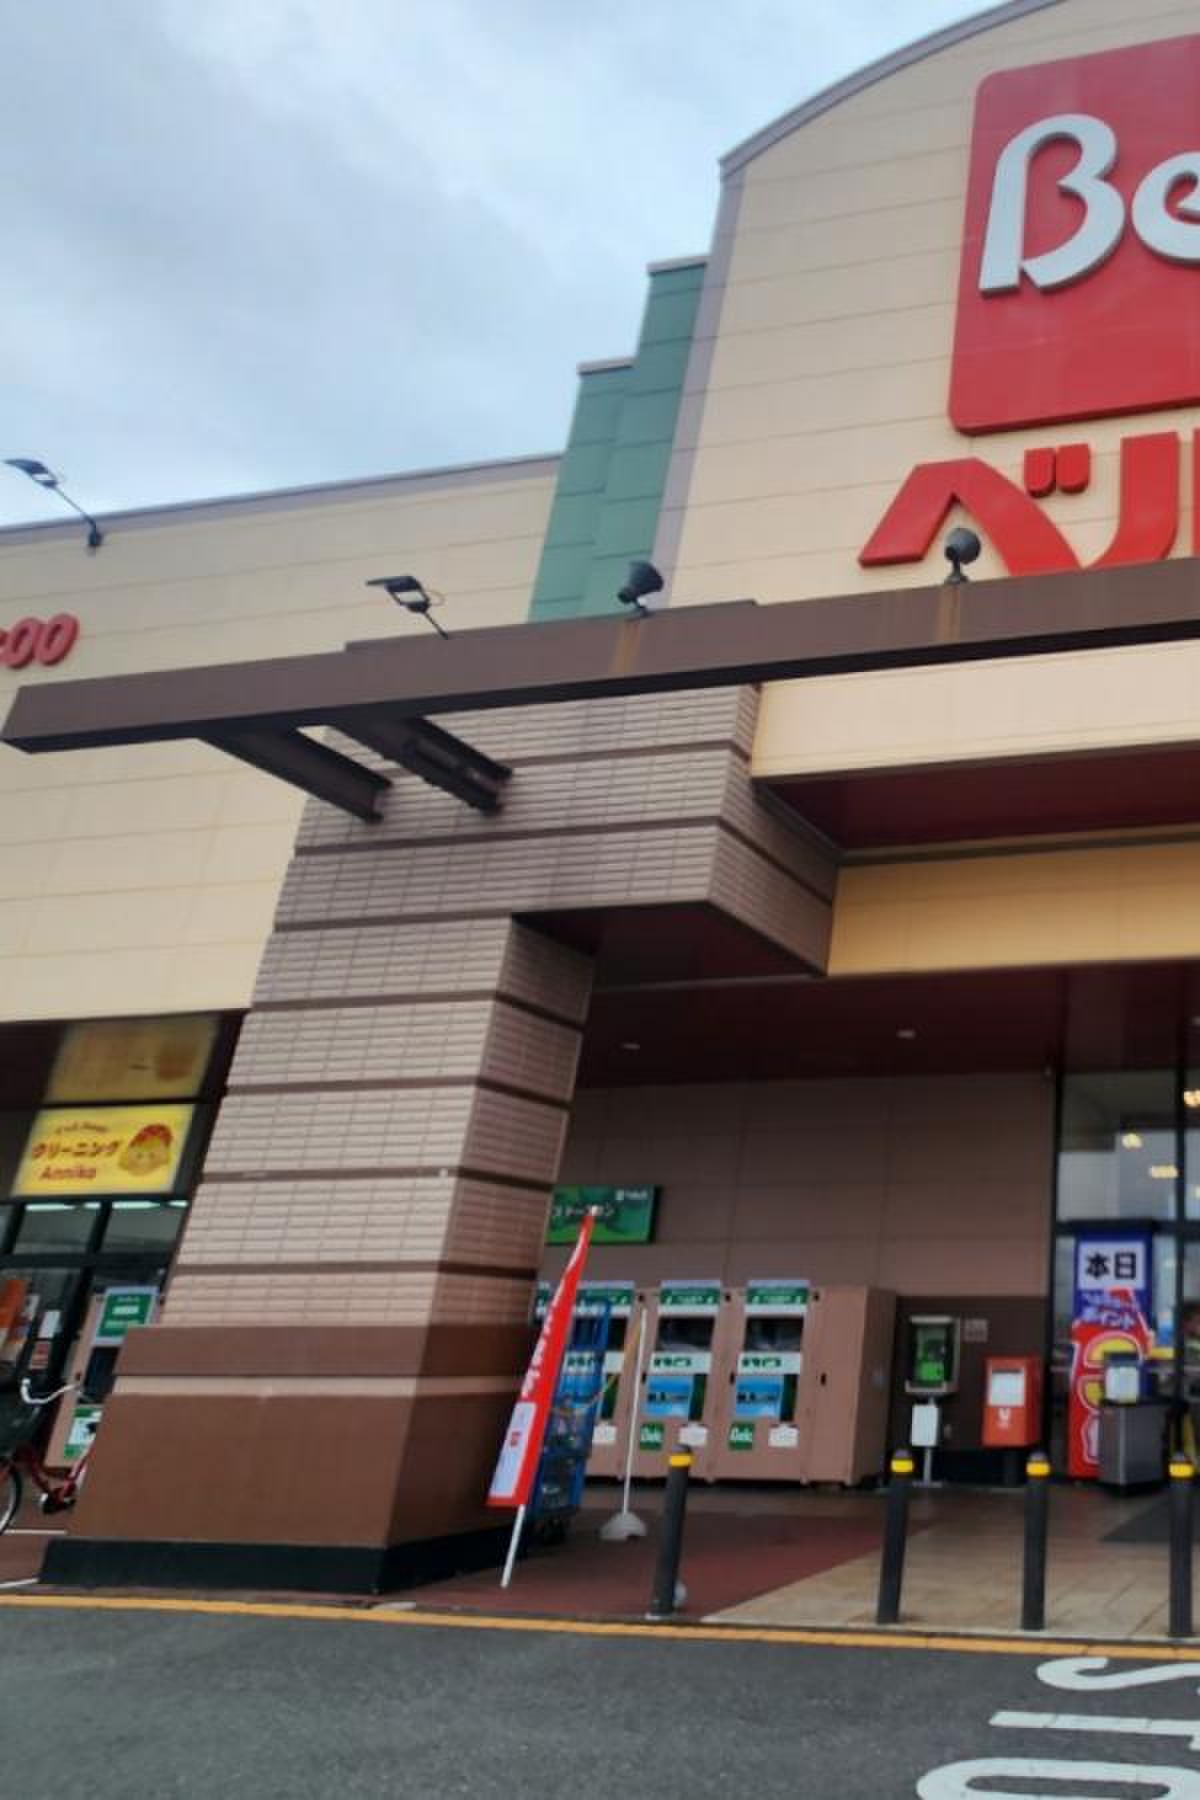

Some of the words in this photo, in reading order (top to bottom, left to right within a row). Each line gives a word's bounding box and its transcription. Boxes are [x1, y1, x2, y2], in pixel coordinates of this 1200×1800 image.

[33, 1140, 121, 1160] クリーニング
[1085, 1251, 1137, 1280] 本日
